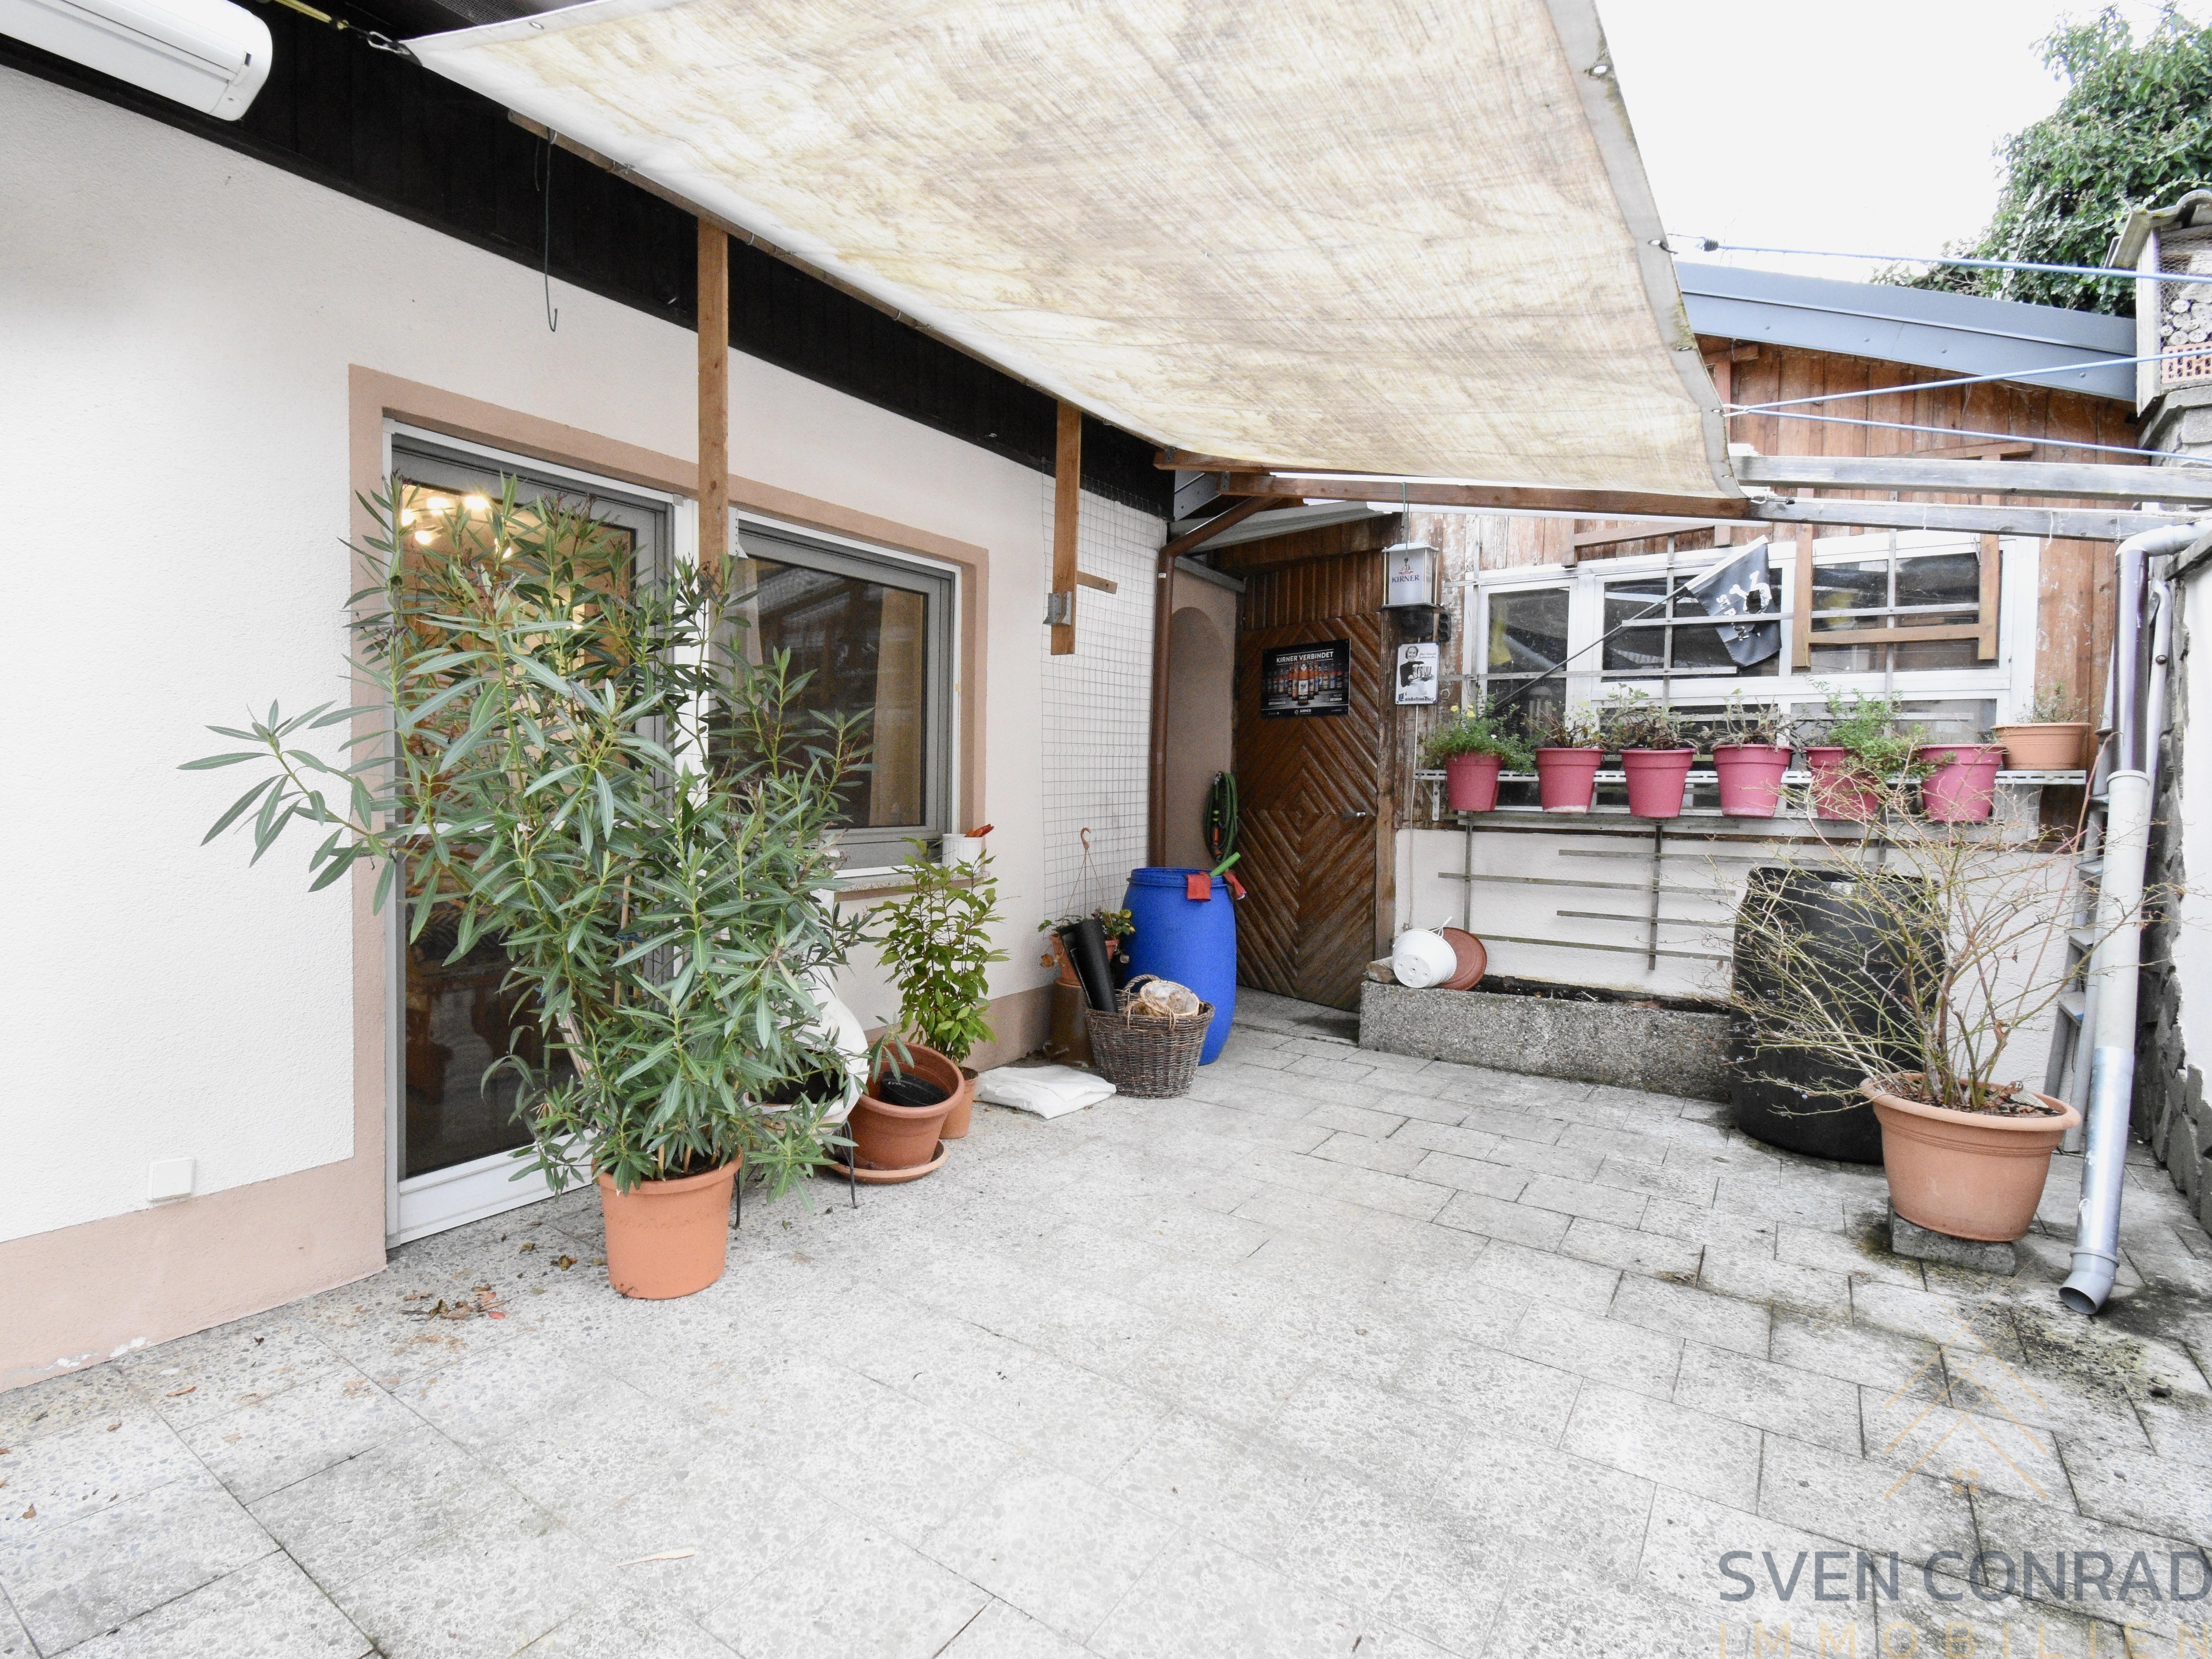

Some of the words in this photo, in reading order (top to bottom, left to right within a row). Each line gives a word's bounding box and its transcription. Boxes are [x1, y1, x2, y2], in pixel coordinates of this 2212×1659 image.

[1392, 574, 1419, 583] KIRNER
[1276, 655, 1297, 663] KIRNER
[1299, 651, 1334, 660] VERBINDET
